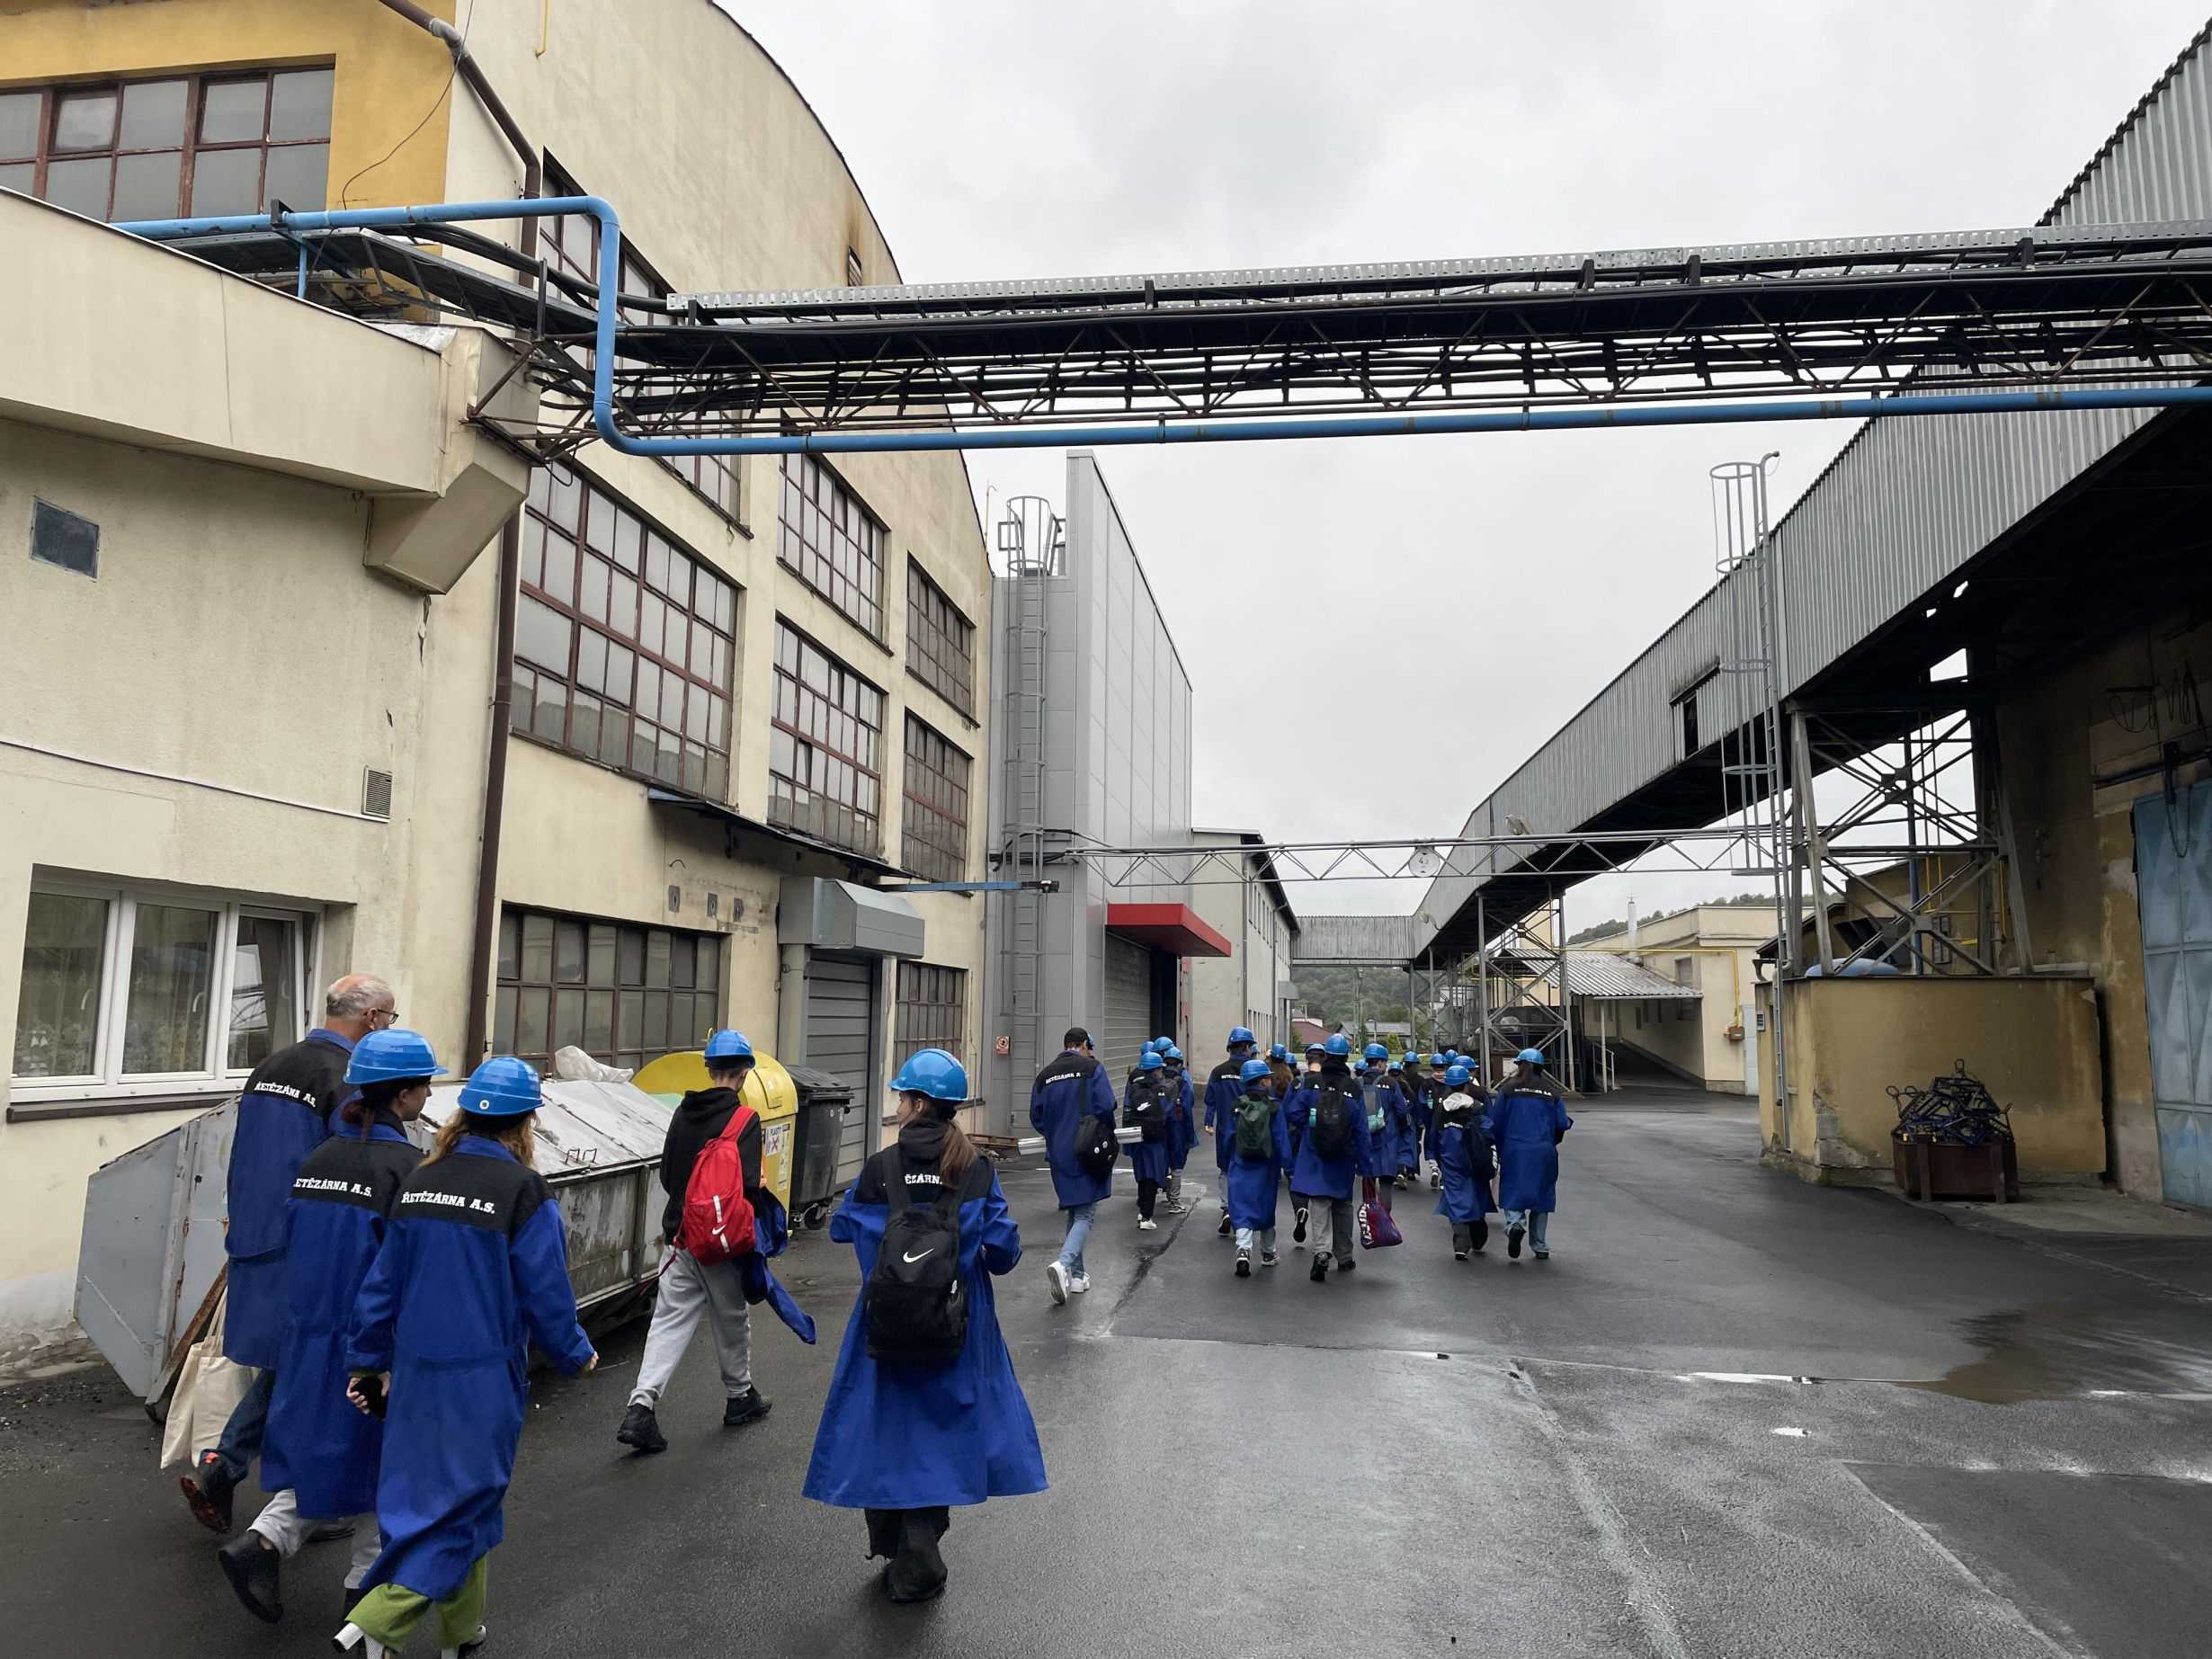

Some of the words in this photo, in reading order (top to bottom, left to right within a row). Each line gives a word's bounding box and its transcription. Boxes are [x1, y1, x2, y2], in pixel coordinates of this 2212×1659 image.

[292, 1177, 348, 1191] ETĚZÁRNA
[351, 1182, 372, 1198] A.S.
[469, 1199, 495, 1214] A.S.
